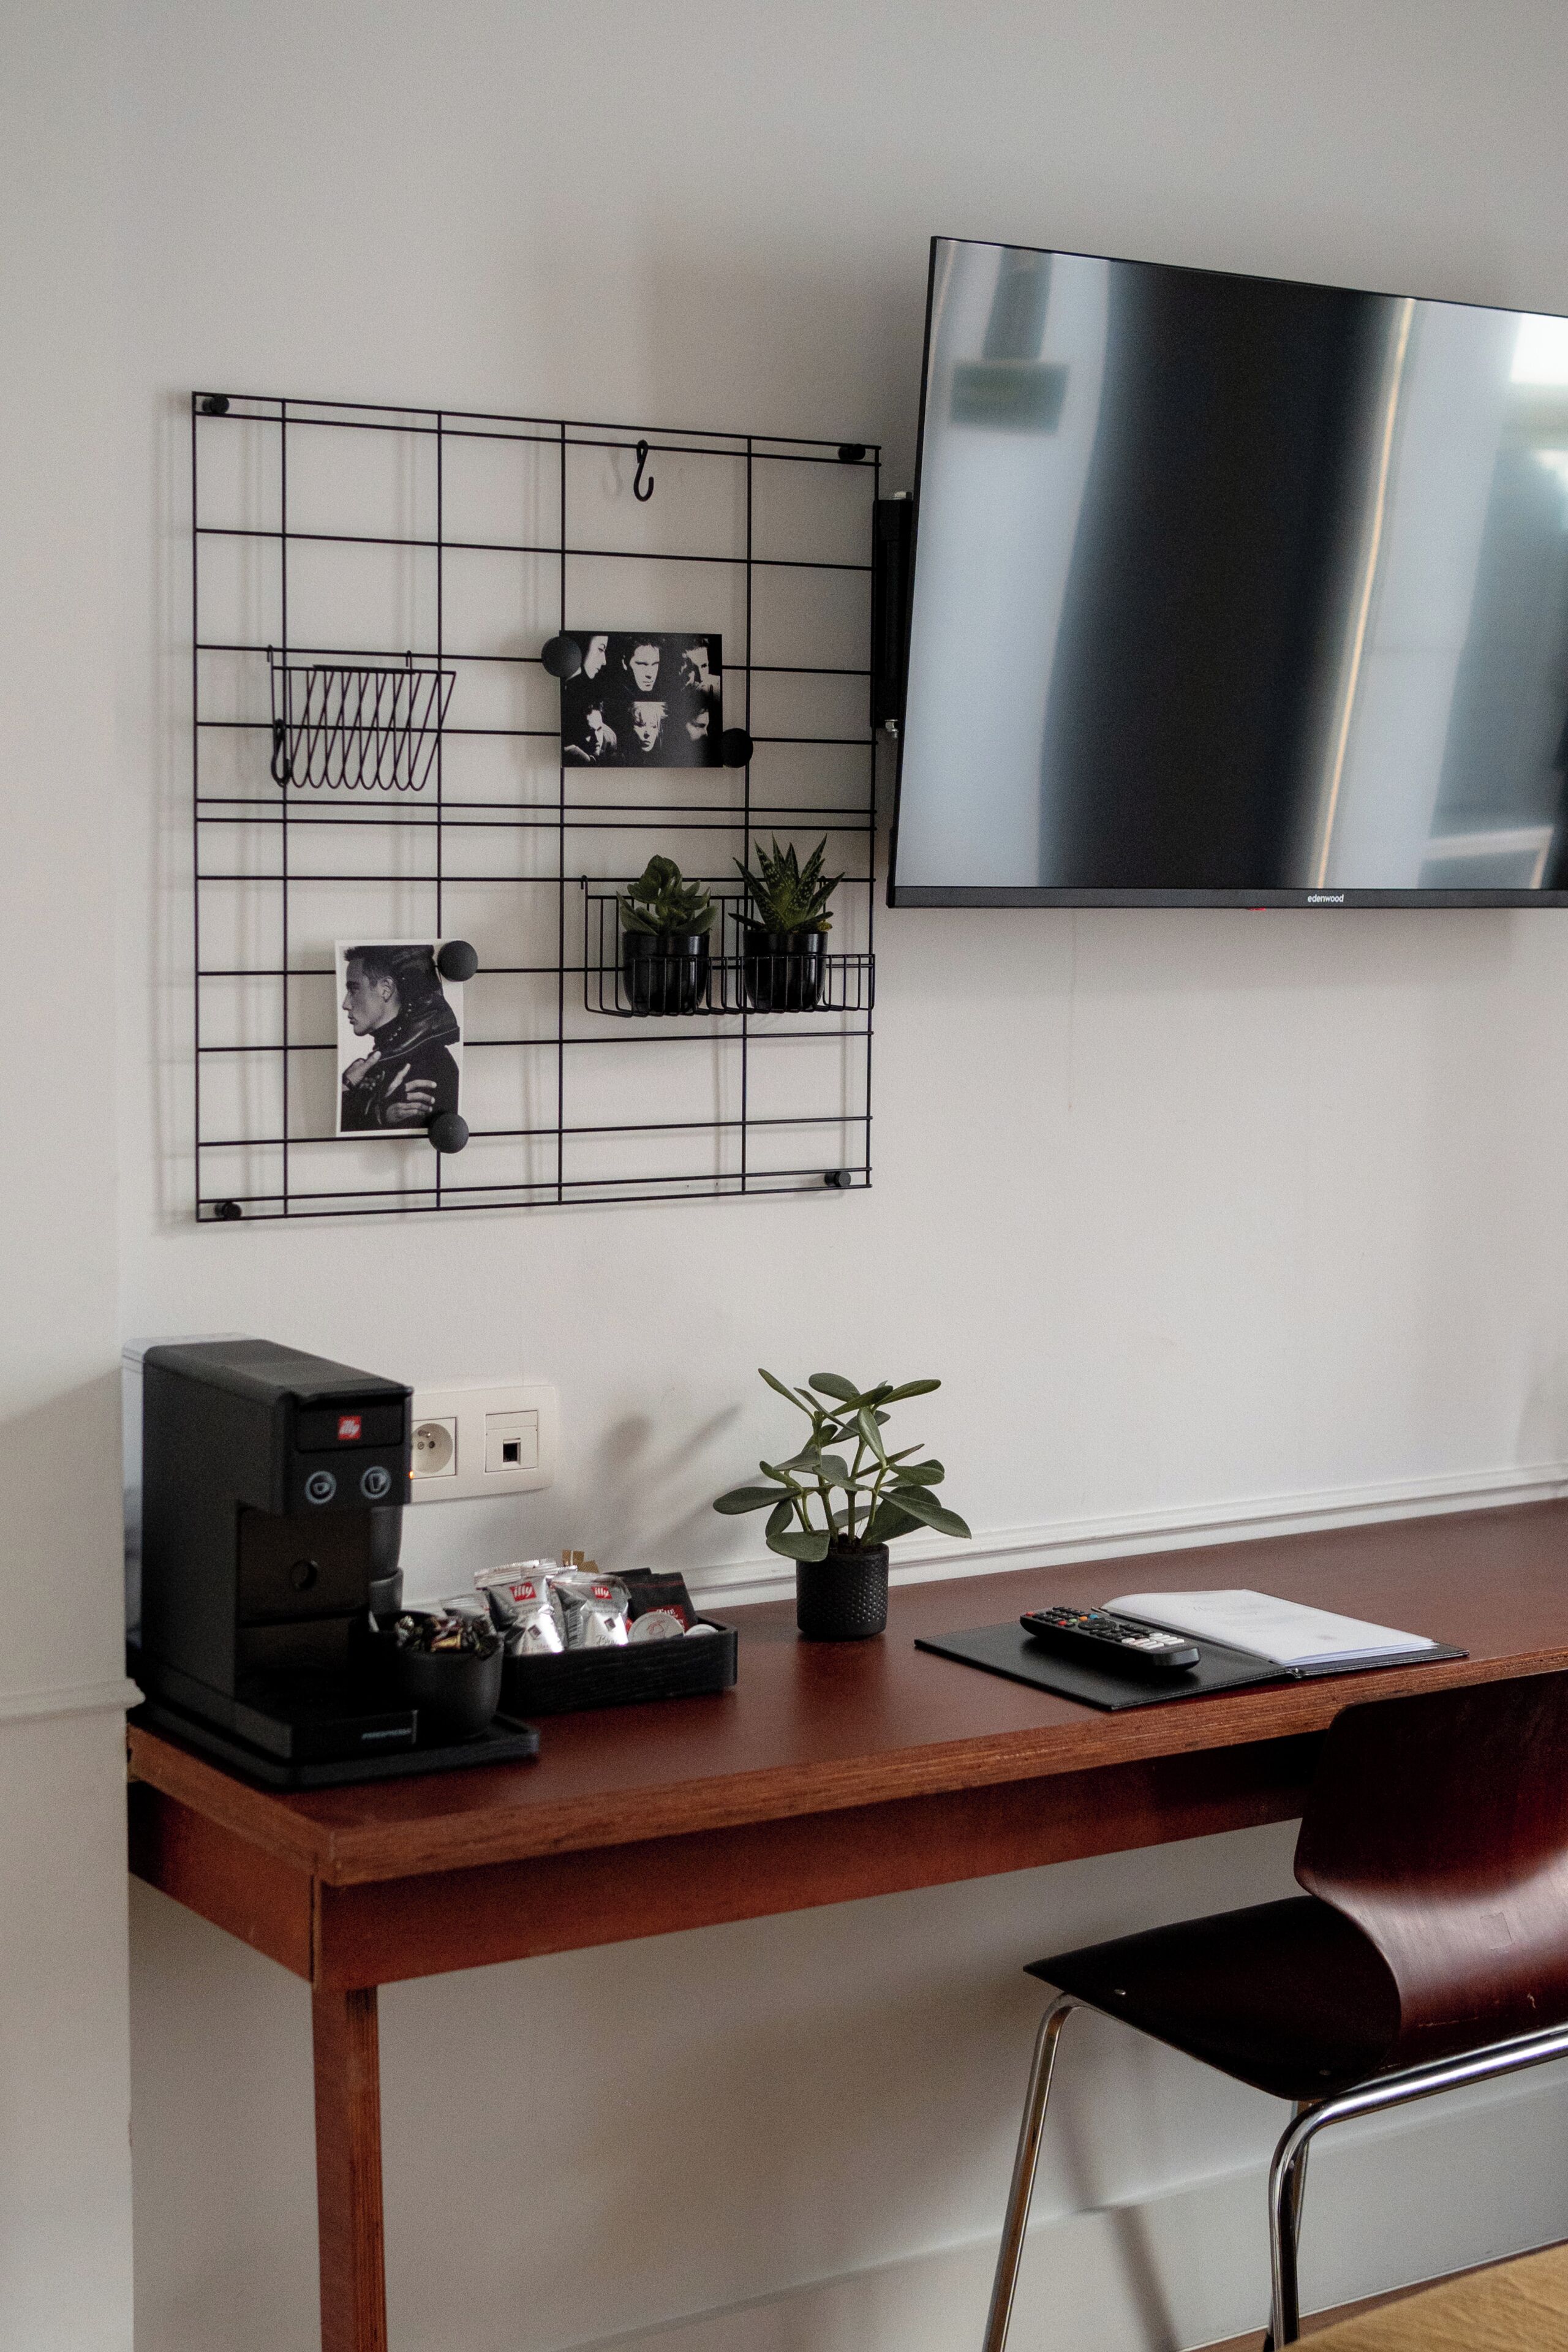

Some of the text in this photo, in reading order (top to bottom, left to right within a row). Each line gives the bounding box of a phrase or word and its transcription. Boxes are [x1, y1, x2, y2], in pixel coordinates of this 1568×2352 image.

[1307, 894, 1344, 902] edenwood
[514, 1585, 533, 1597] illy
[594, 1587, 609, 1598] illy
